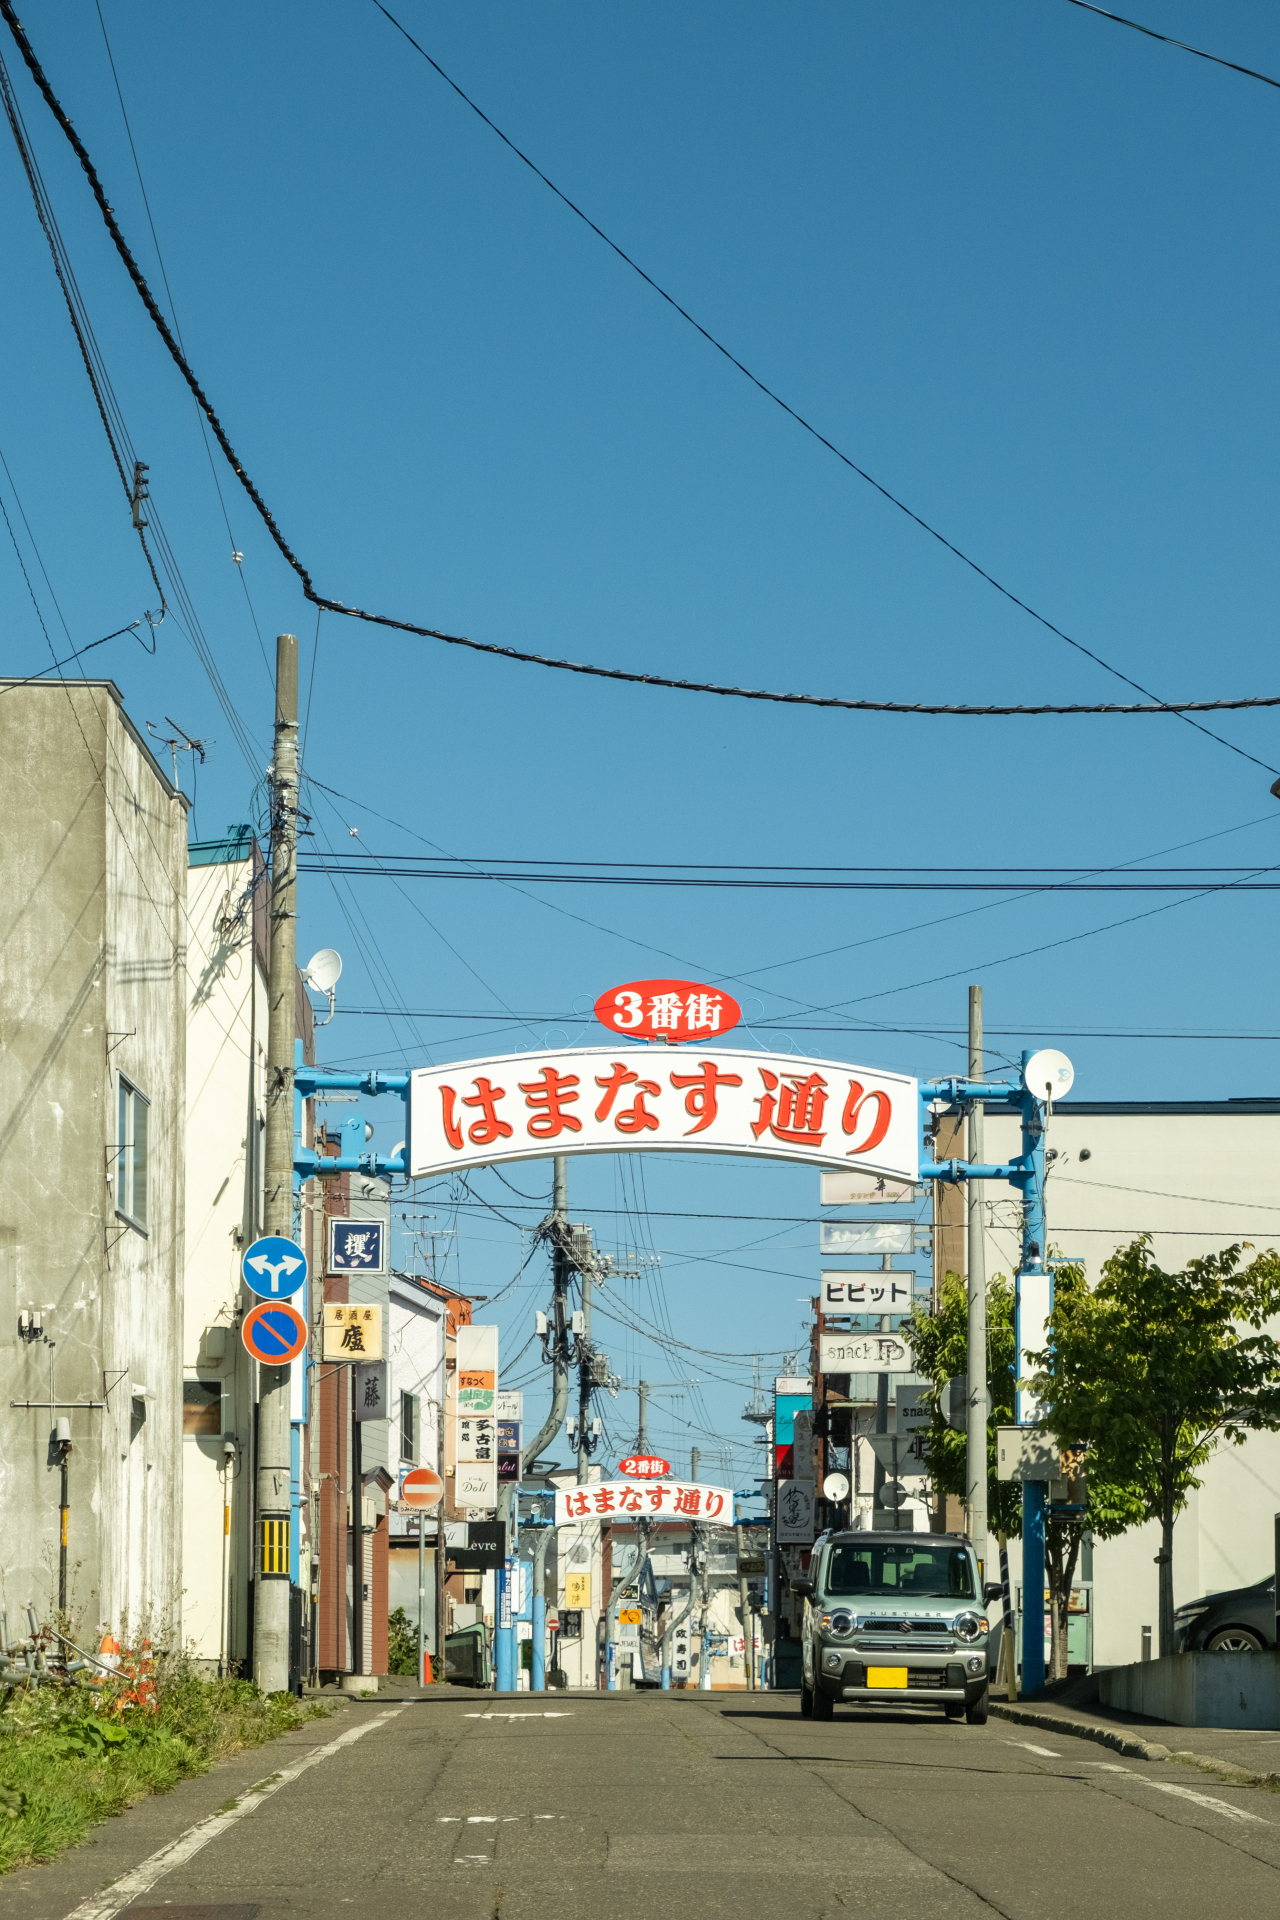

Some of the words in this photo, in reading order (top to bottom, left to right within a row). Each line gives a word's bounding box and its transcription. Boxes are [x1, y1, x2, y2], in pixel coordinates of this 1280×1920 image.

[612, 990, 724, 1032] 3番街
[437, 1060, 894, 1156] はまなす通り
[825, 1281, 908, 1304] ビビット
[334, 1309, 373, 1321] 居酒屋
[827, 1341, 873, 1361] snack
[363, 1375, 381, 1408] 藤
[497, 1401, 519, 1411] ンドール
[902, 1406, 931, 1418] snac
[497, 1461, 516, 1472] alut
[625, 1459, 664, 1475] 2番街
[462, 1481, 489, 1493] Doll
[564, 1484, 724, 1519] はまなす通り
[463, 1540, 497, 1551] èvre
[870, 1610, 942, 1618] HUSTLER
